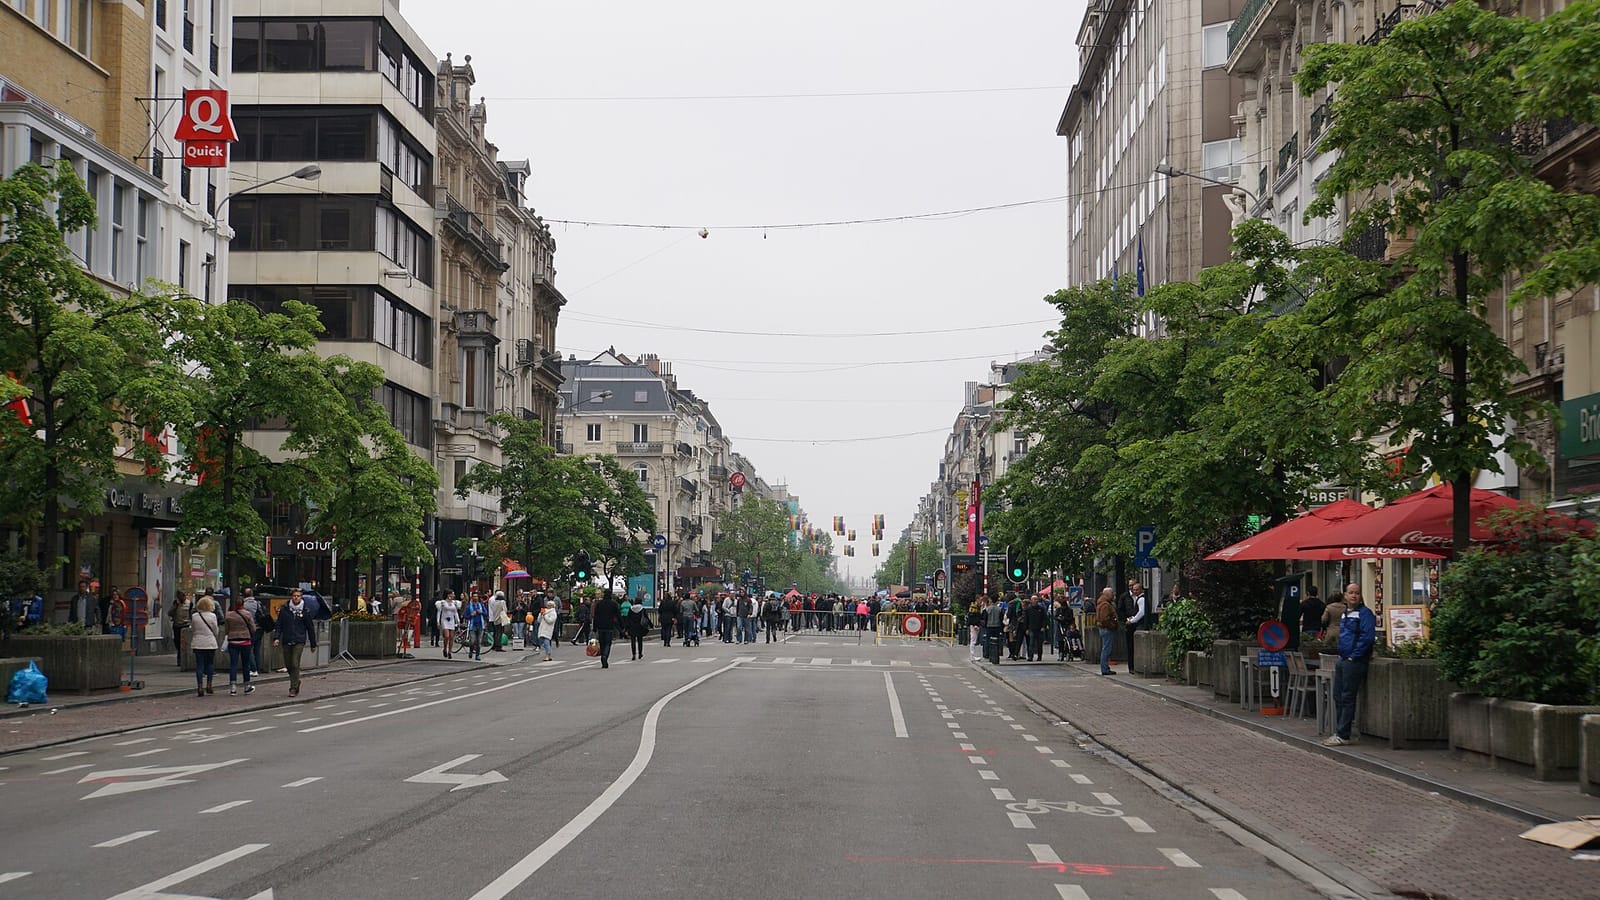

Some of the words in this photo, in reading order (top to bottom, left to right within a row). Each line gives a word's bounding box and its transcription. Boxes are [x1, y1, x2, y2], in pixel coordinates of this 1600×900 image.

[189, 95, 223, 133] Q
[186, 145, 223, 158] Quick
[1138, 530, 1153, 552] P
[1290, 585, 1298, 597] P
